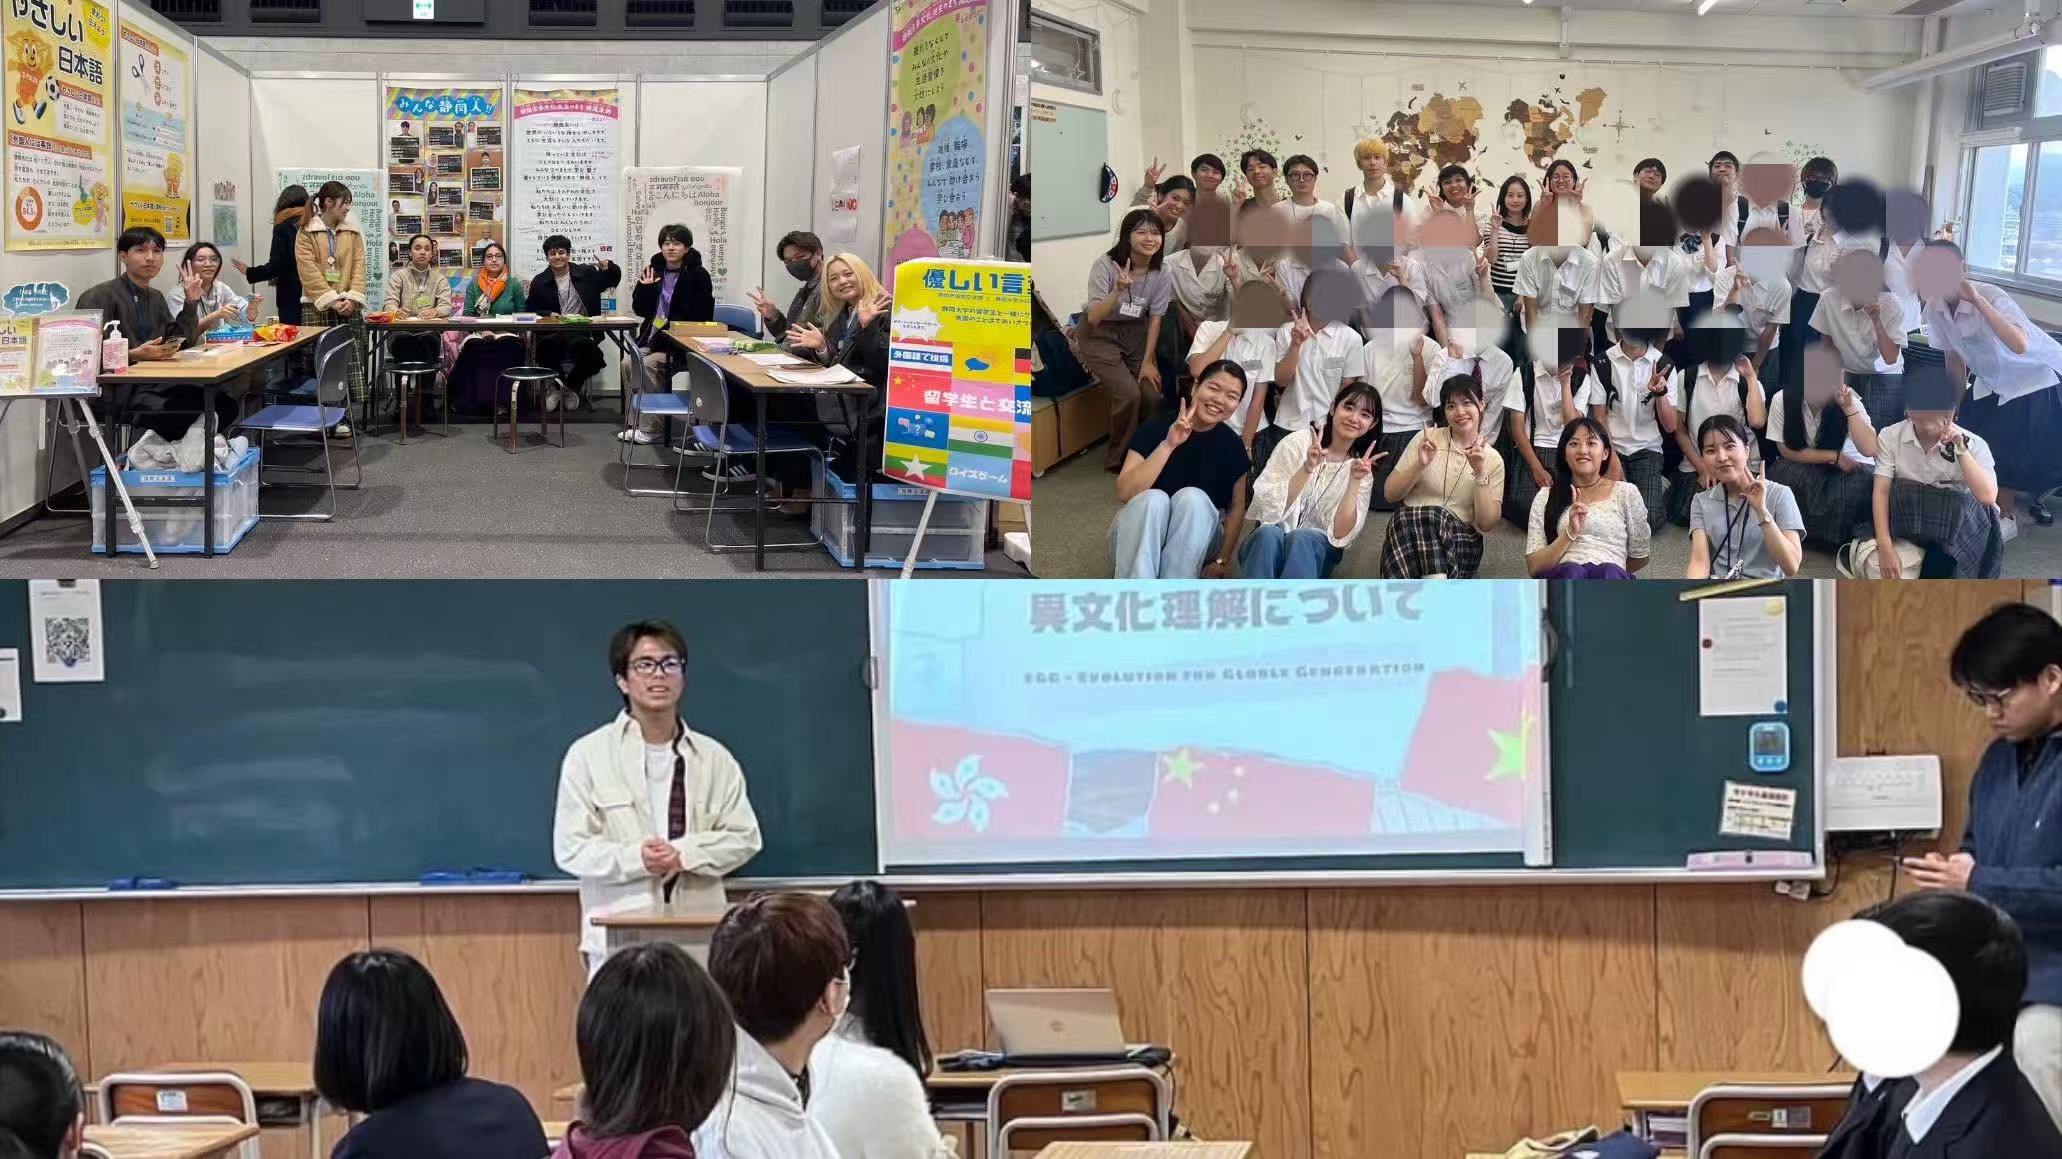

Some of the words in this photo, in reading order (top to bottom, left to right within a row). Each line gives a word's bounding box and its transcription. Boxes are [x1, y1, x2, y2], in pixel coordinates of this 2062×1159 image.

[59, 46, 103, 85] 日本語
[655, 191, 697, 199] こんにちは
[693, 199, 723, 207] Bonjour
[923, 269, 1031, 295] 優しい言
[924, 389, 1031, 416] 留学生と交流
[948, 467, 1009, 484] クイズゲーム
[1030, 584, 1424, 634] 異文化理解について
